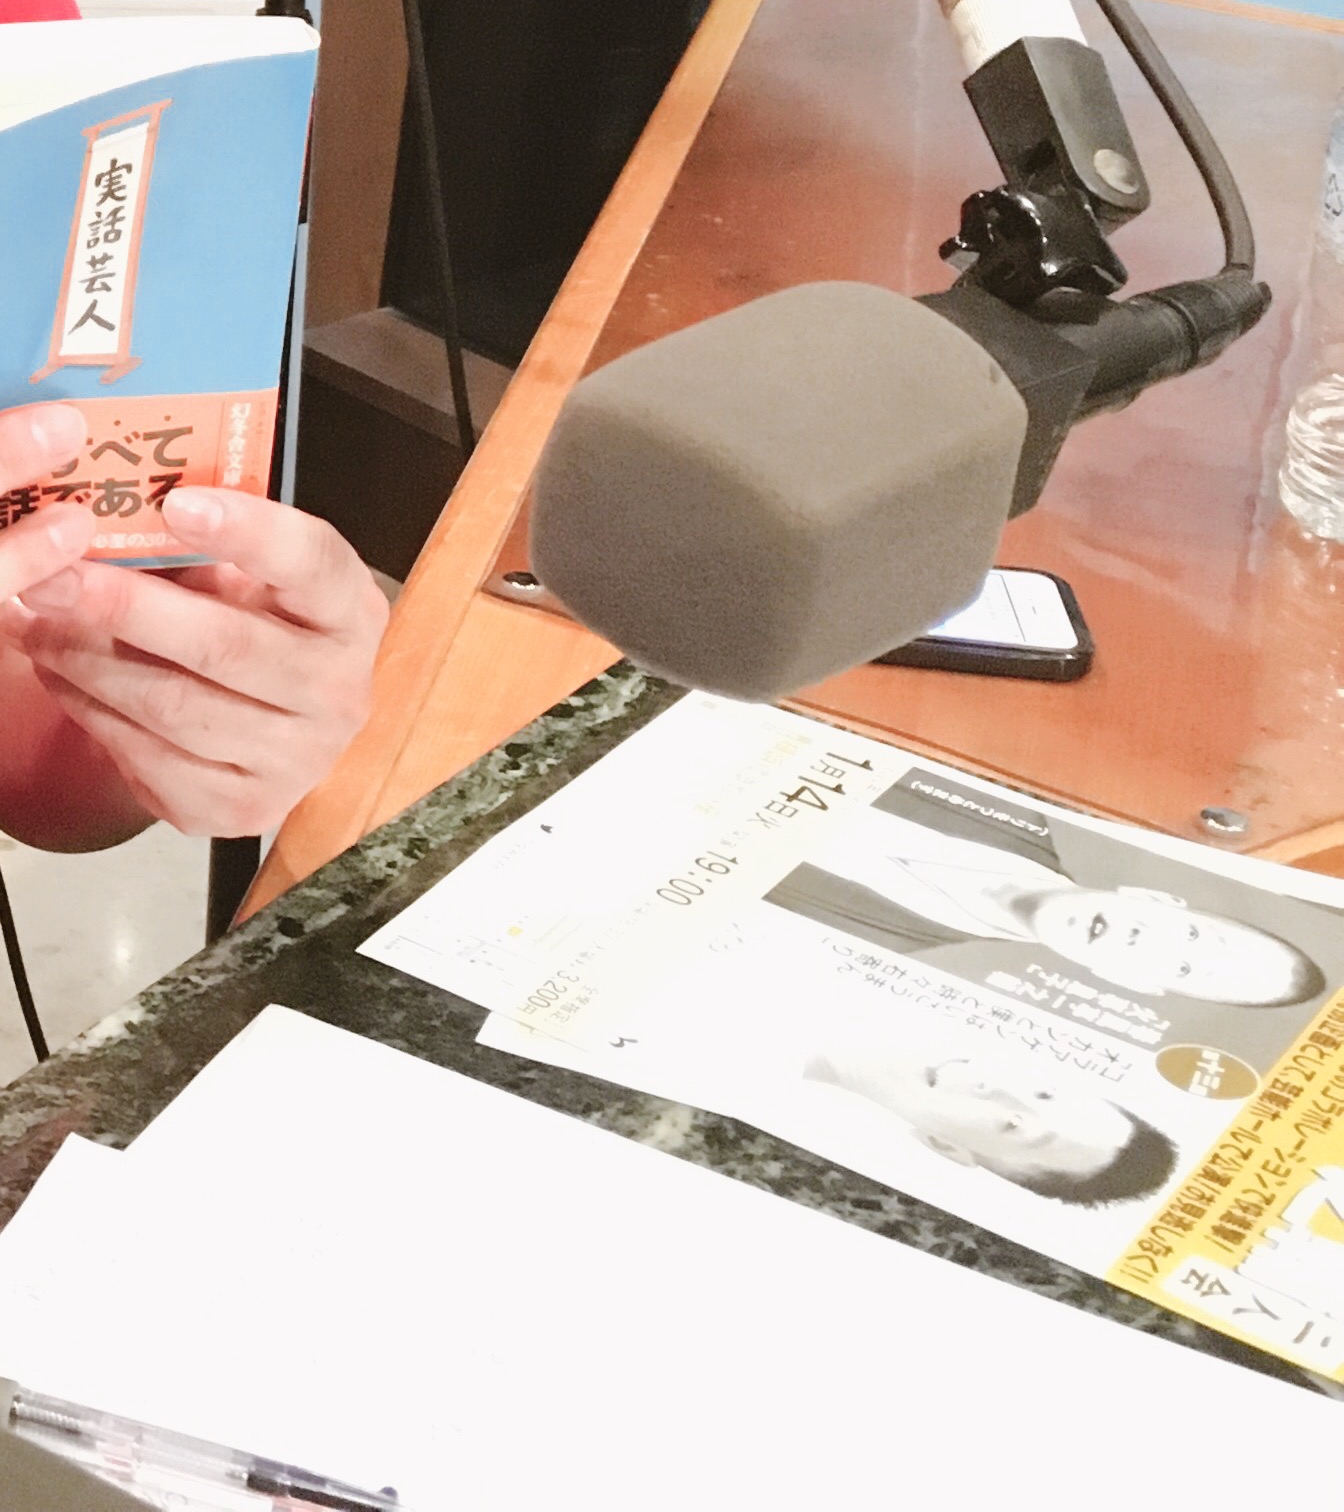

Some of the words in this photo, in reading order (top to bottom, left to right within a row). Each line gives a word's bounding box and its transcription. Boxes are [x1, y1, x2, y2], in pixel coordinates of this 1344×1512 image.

[68, 157, 132, 336] 実話芸人
[52, 425, 194, 478] べて
[656, 851, 738, 905] 19:00
